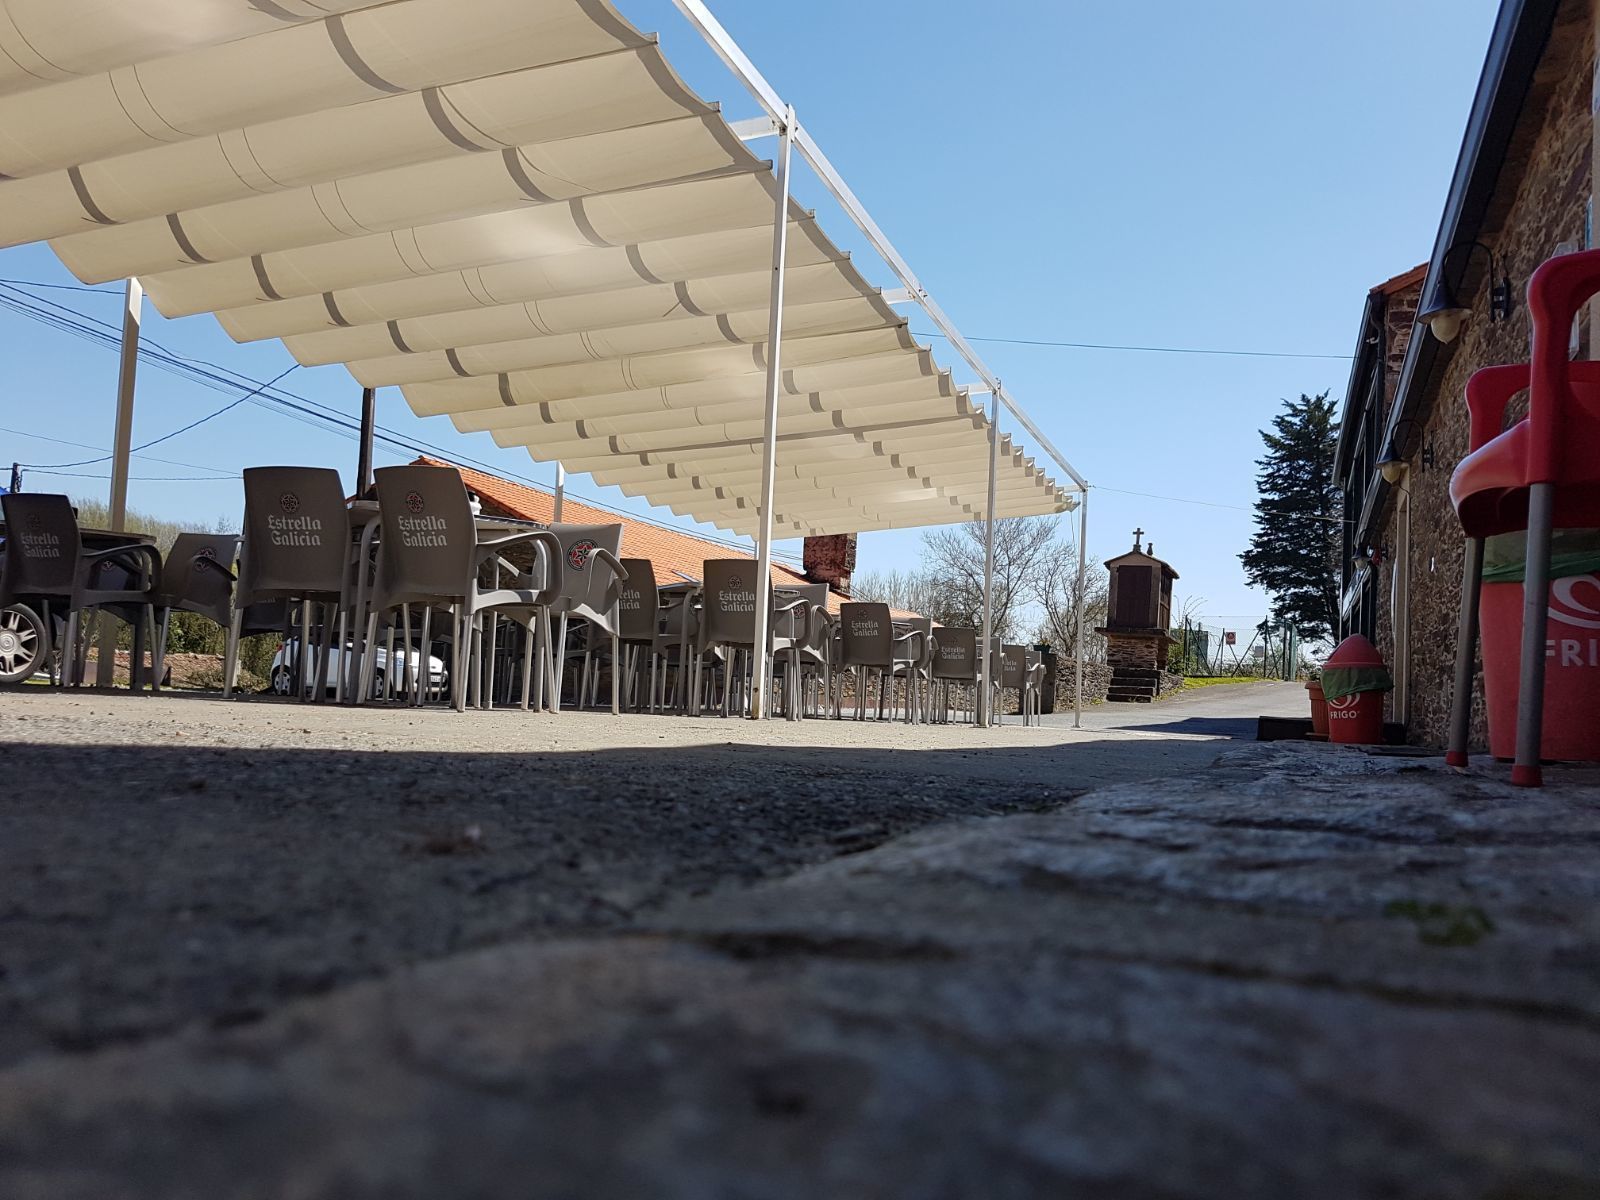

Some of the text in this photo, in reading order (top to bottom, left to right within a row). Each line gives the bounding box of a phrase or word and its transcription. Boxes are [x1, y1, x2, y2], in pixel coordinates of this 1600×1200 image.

[268, 515, 321, 530] Estrella
[398, 515, 447, 530] Estrella
[271, 530, 321, 546] Galicia
[402, 531, 447, 546] Galicia
[719, 590, 755, 601] Estrella
[720, 601, 754, 612] Galicia
[1330, 710, 1357, 720] FRIGO
